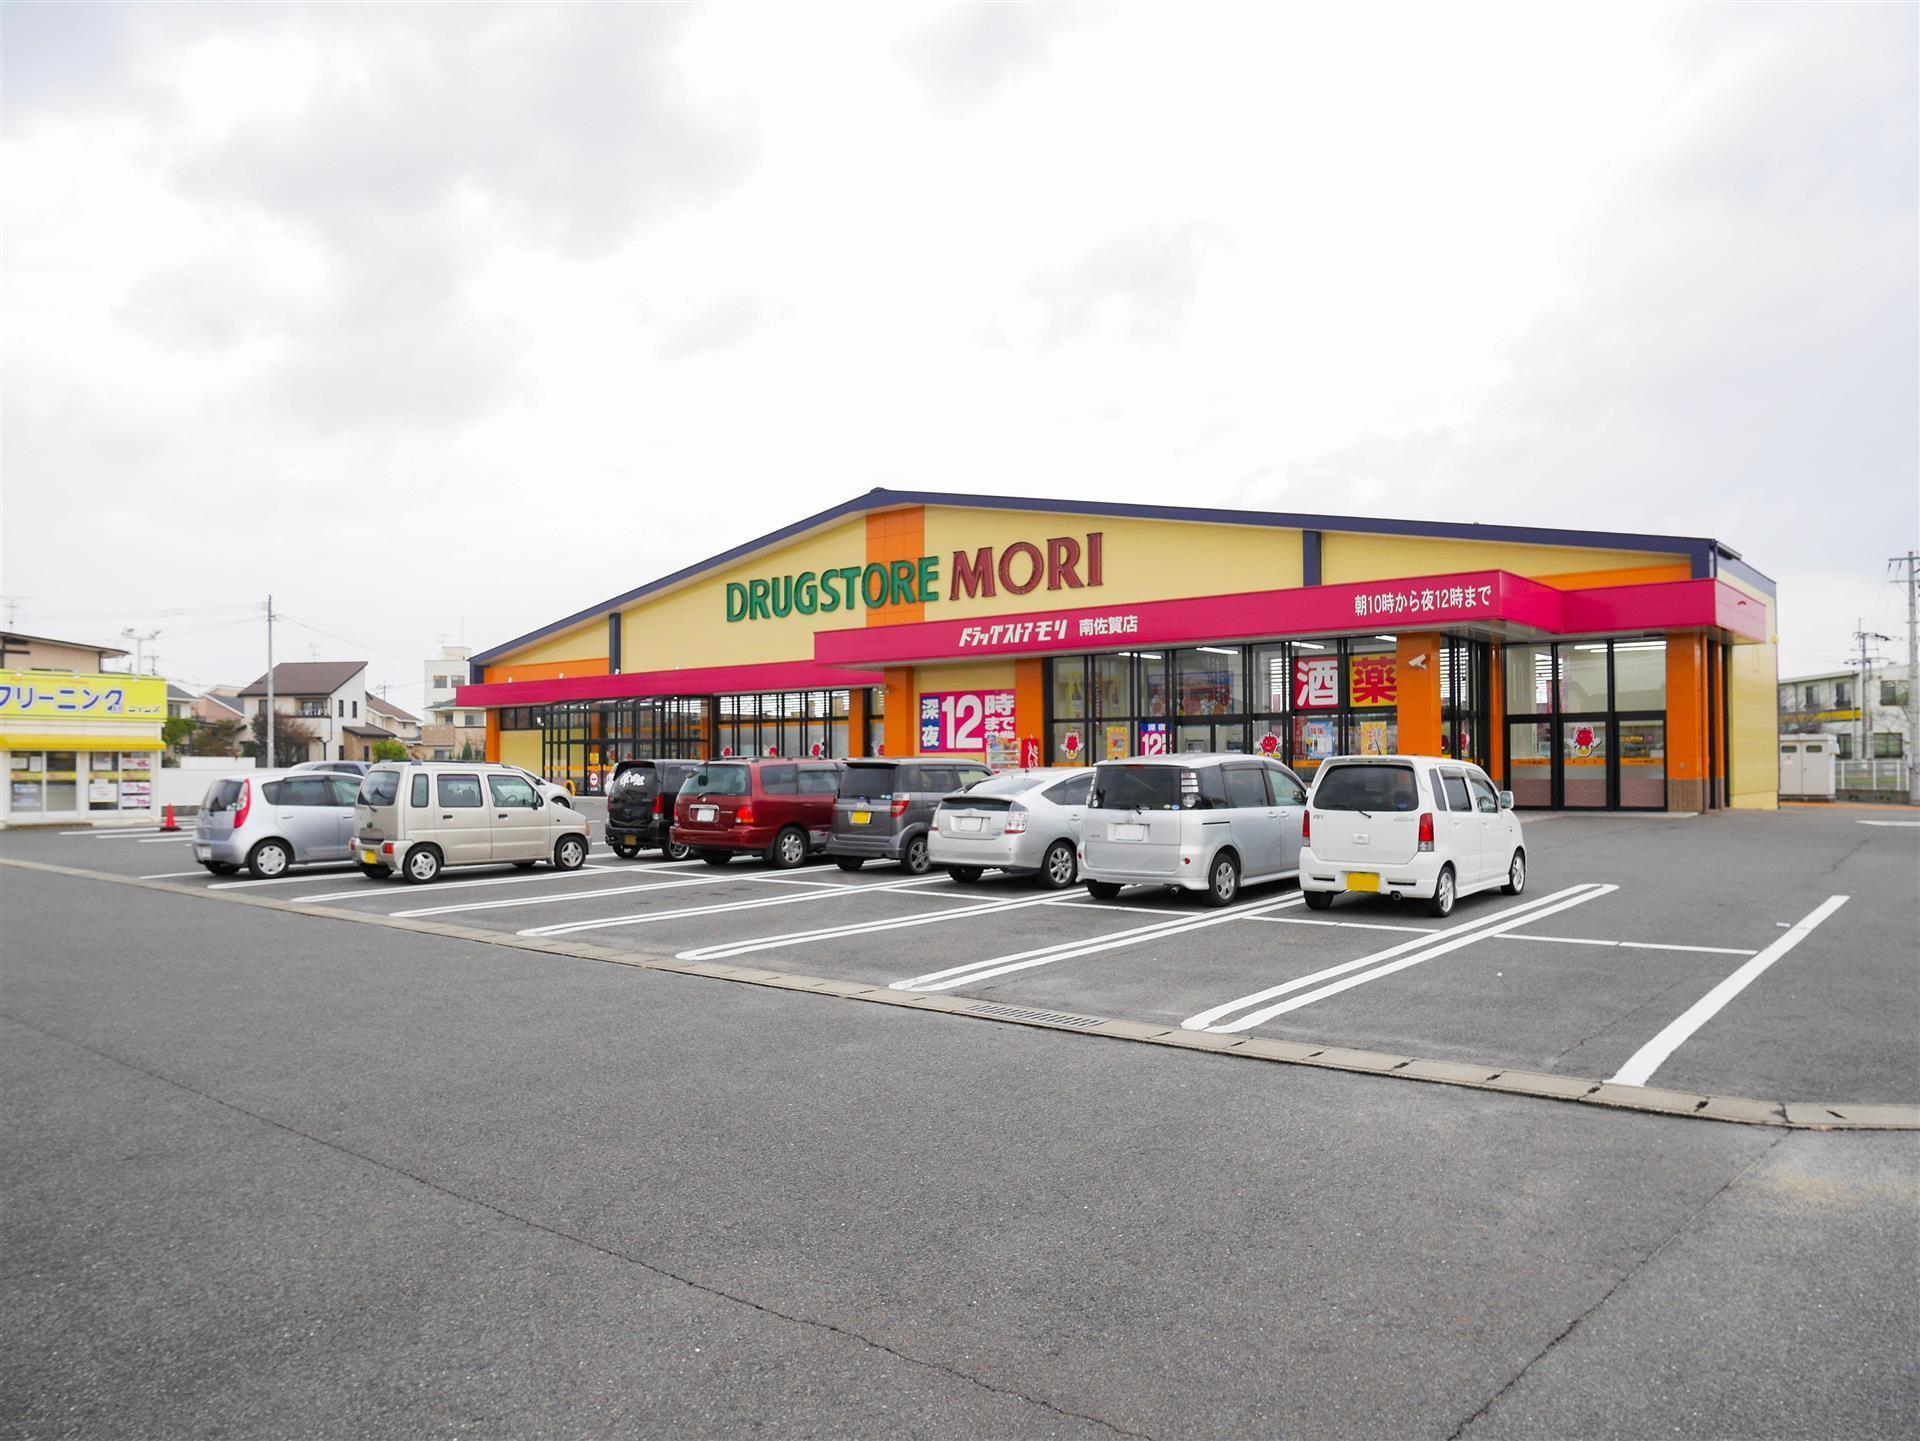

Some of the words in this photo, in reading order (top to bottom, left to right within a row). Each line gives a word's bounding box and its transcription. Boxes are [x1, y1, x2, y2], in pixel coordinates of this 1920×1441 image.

[726, 556, 939, 622] DRUGSTORE
[950, 532, 1103, 601] MORI
[1354, 585, 1491, 616] 朝10時から夜12時まで
[1079, 615, 1138, 636] 南佐賀店
[1297, 660, 1338, 706] 酒
[1352, 657, 1397, 704] 薬
